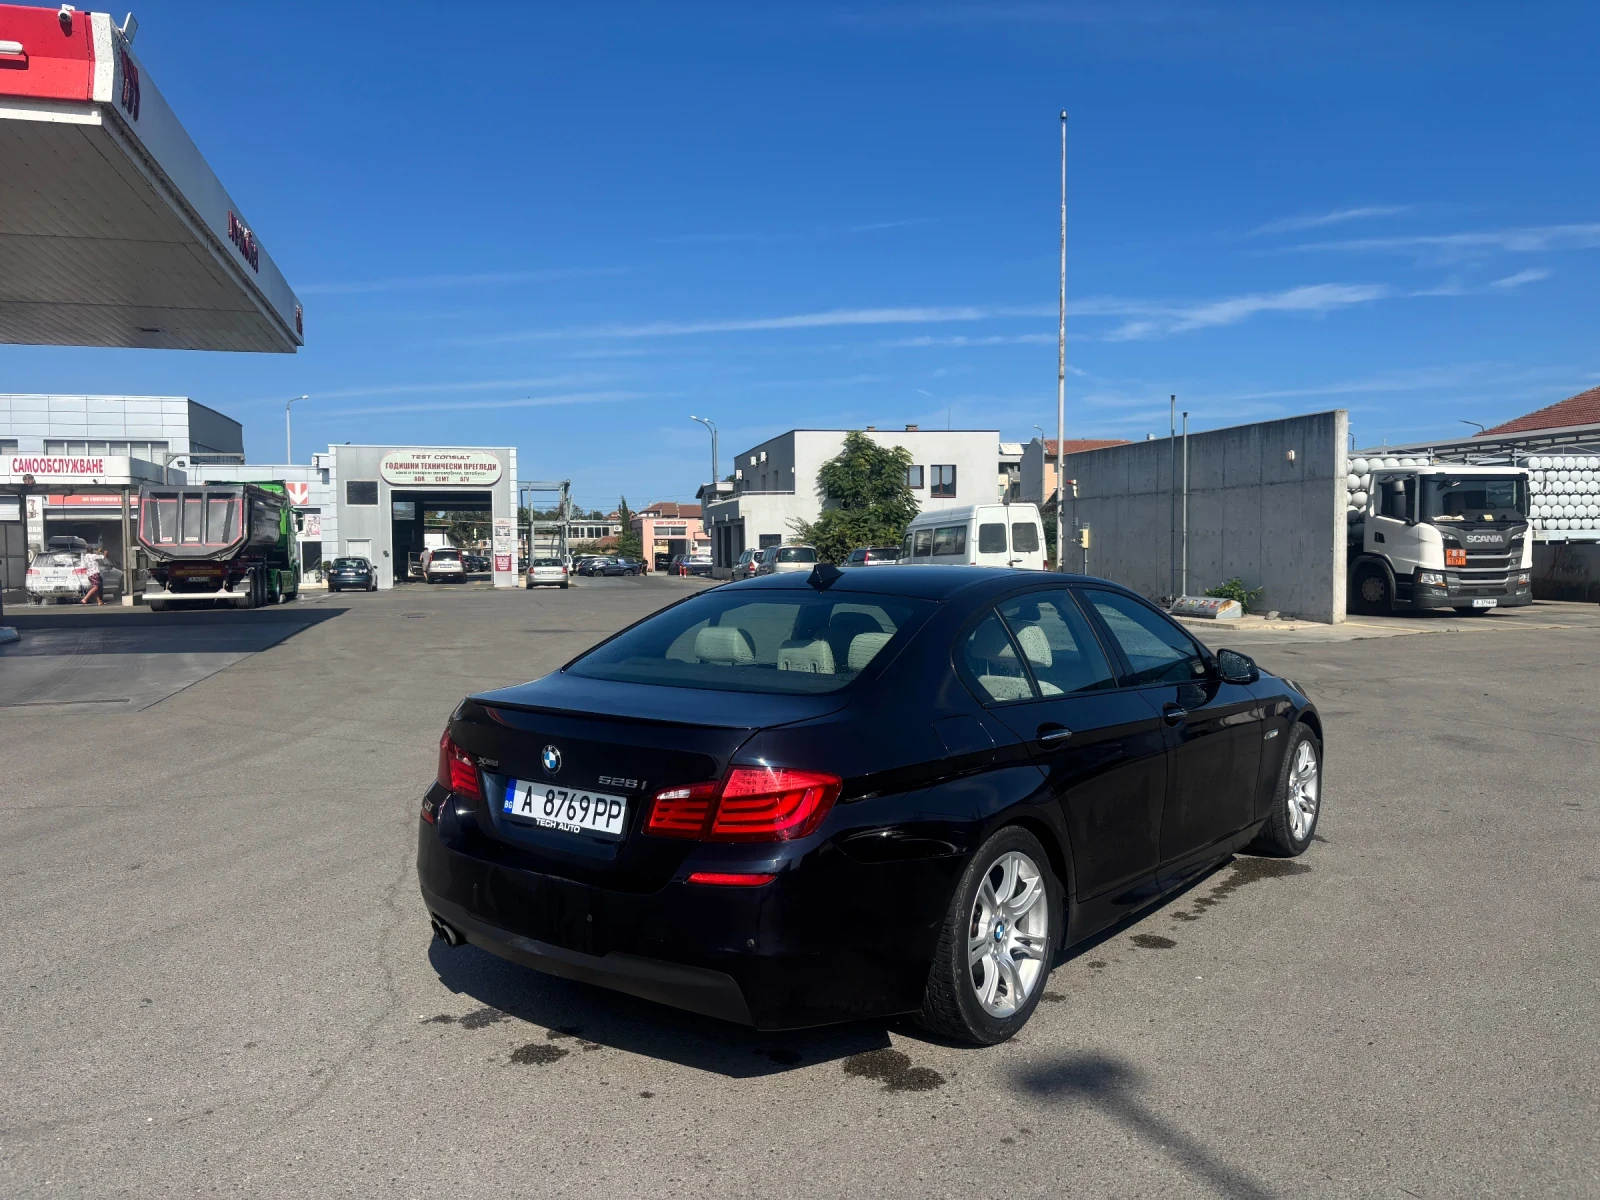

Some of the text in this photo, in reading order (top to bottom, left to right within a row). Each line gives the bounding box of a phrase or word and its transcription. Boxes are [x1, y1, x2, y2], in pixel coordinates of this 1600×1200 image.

[12, 458, 104, 473] САМООБСЛУЖВАНЕ
[385, 462, 497, 471] ГОДИШНИ ТЕХНИЧЕСКИ ПРЕГЛЕДИ
[1466, 535, 1503, 543] SCANIA
[504, 800, 513, 809] BG
[521, 785, 533, 814] A
[535, 817, 581, 834] TECH AUTO
